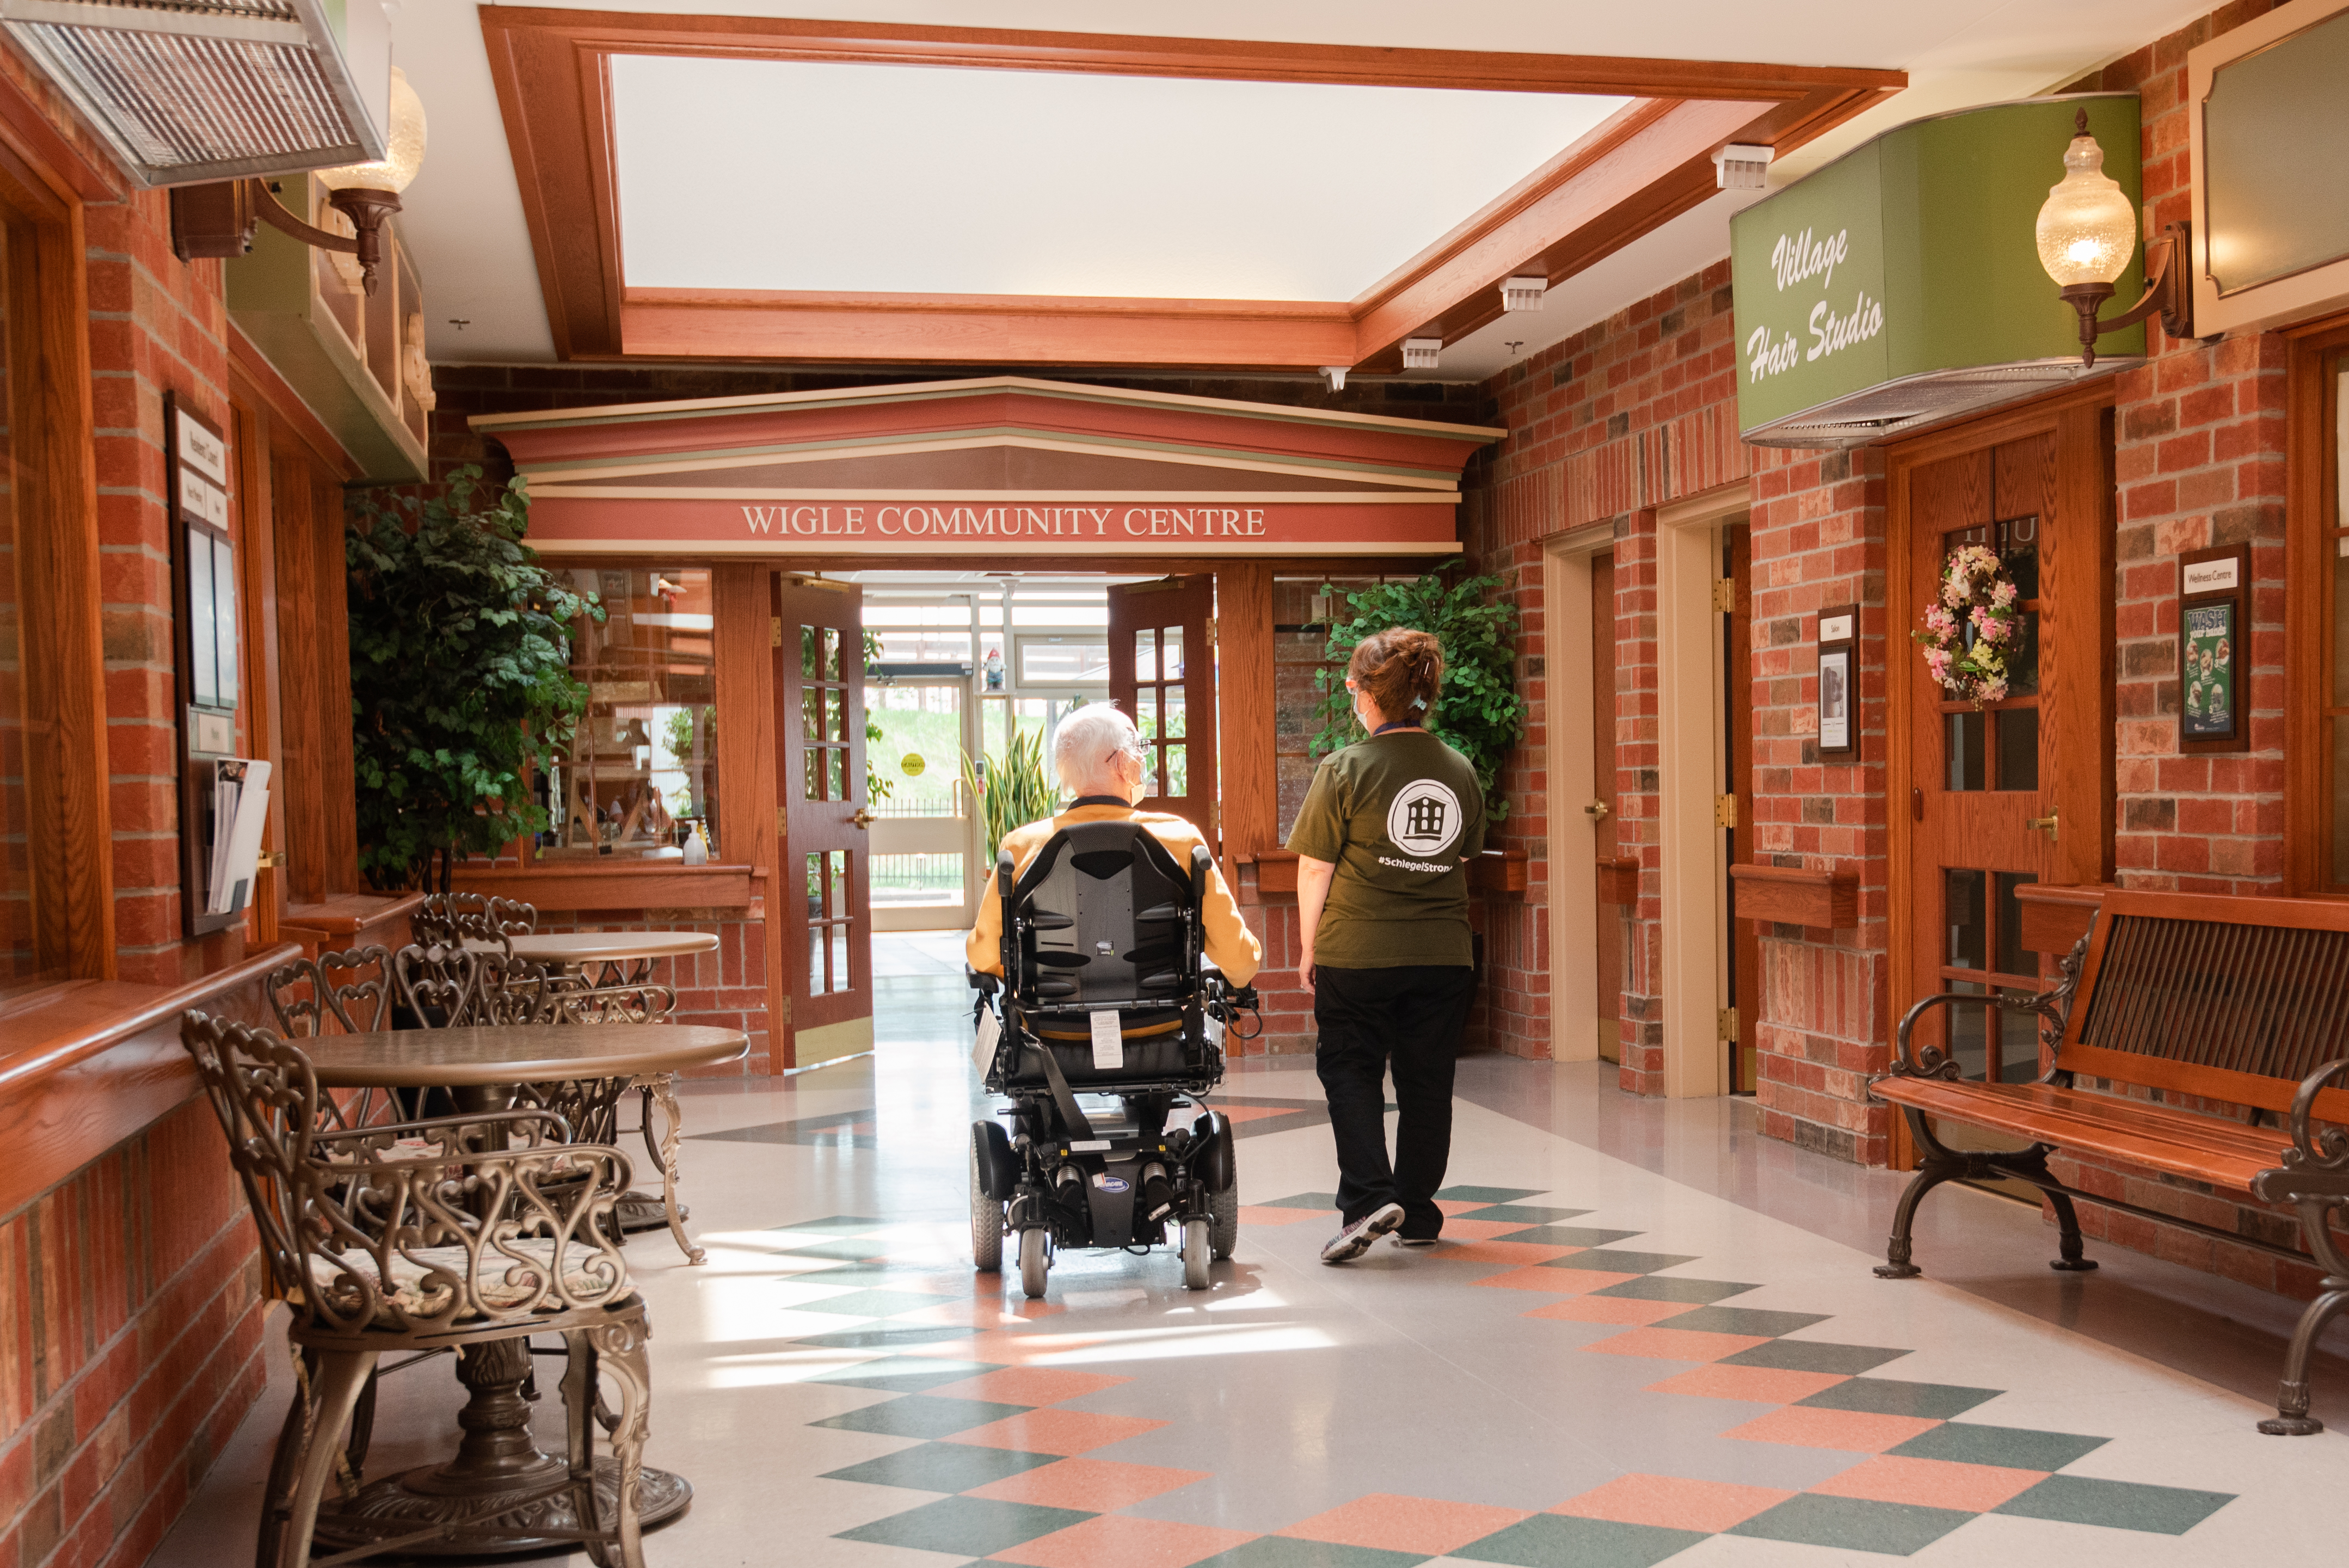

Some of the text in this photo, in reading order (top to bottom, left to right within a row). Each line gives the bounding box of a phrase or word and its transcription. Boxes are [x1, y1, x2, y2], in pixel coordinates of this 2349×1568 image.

[1771, 226, 1848, 292] Village
[1747, 291, 1883, 384] Hair Studio
[741, 506, 1266, 536] WIGLE COMMUNITY CENTRE
[2188, 570, 2231, 583] Wellness Centre
[1831, 624, 1840, 632] Salon
[2187, 609, 2227, 631] WASH
[2190, 625, 2226, 641] your hands
